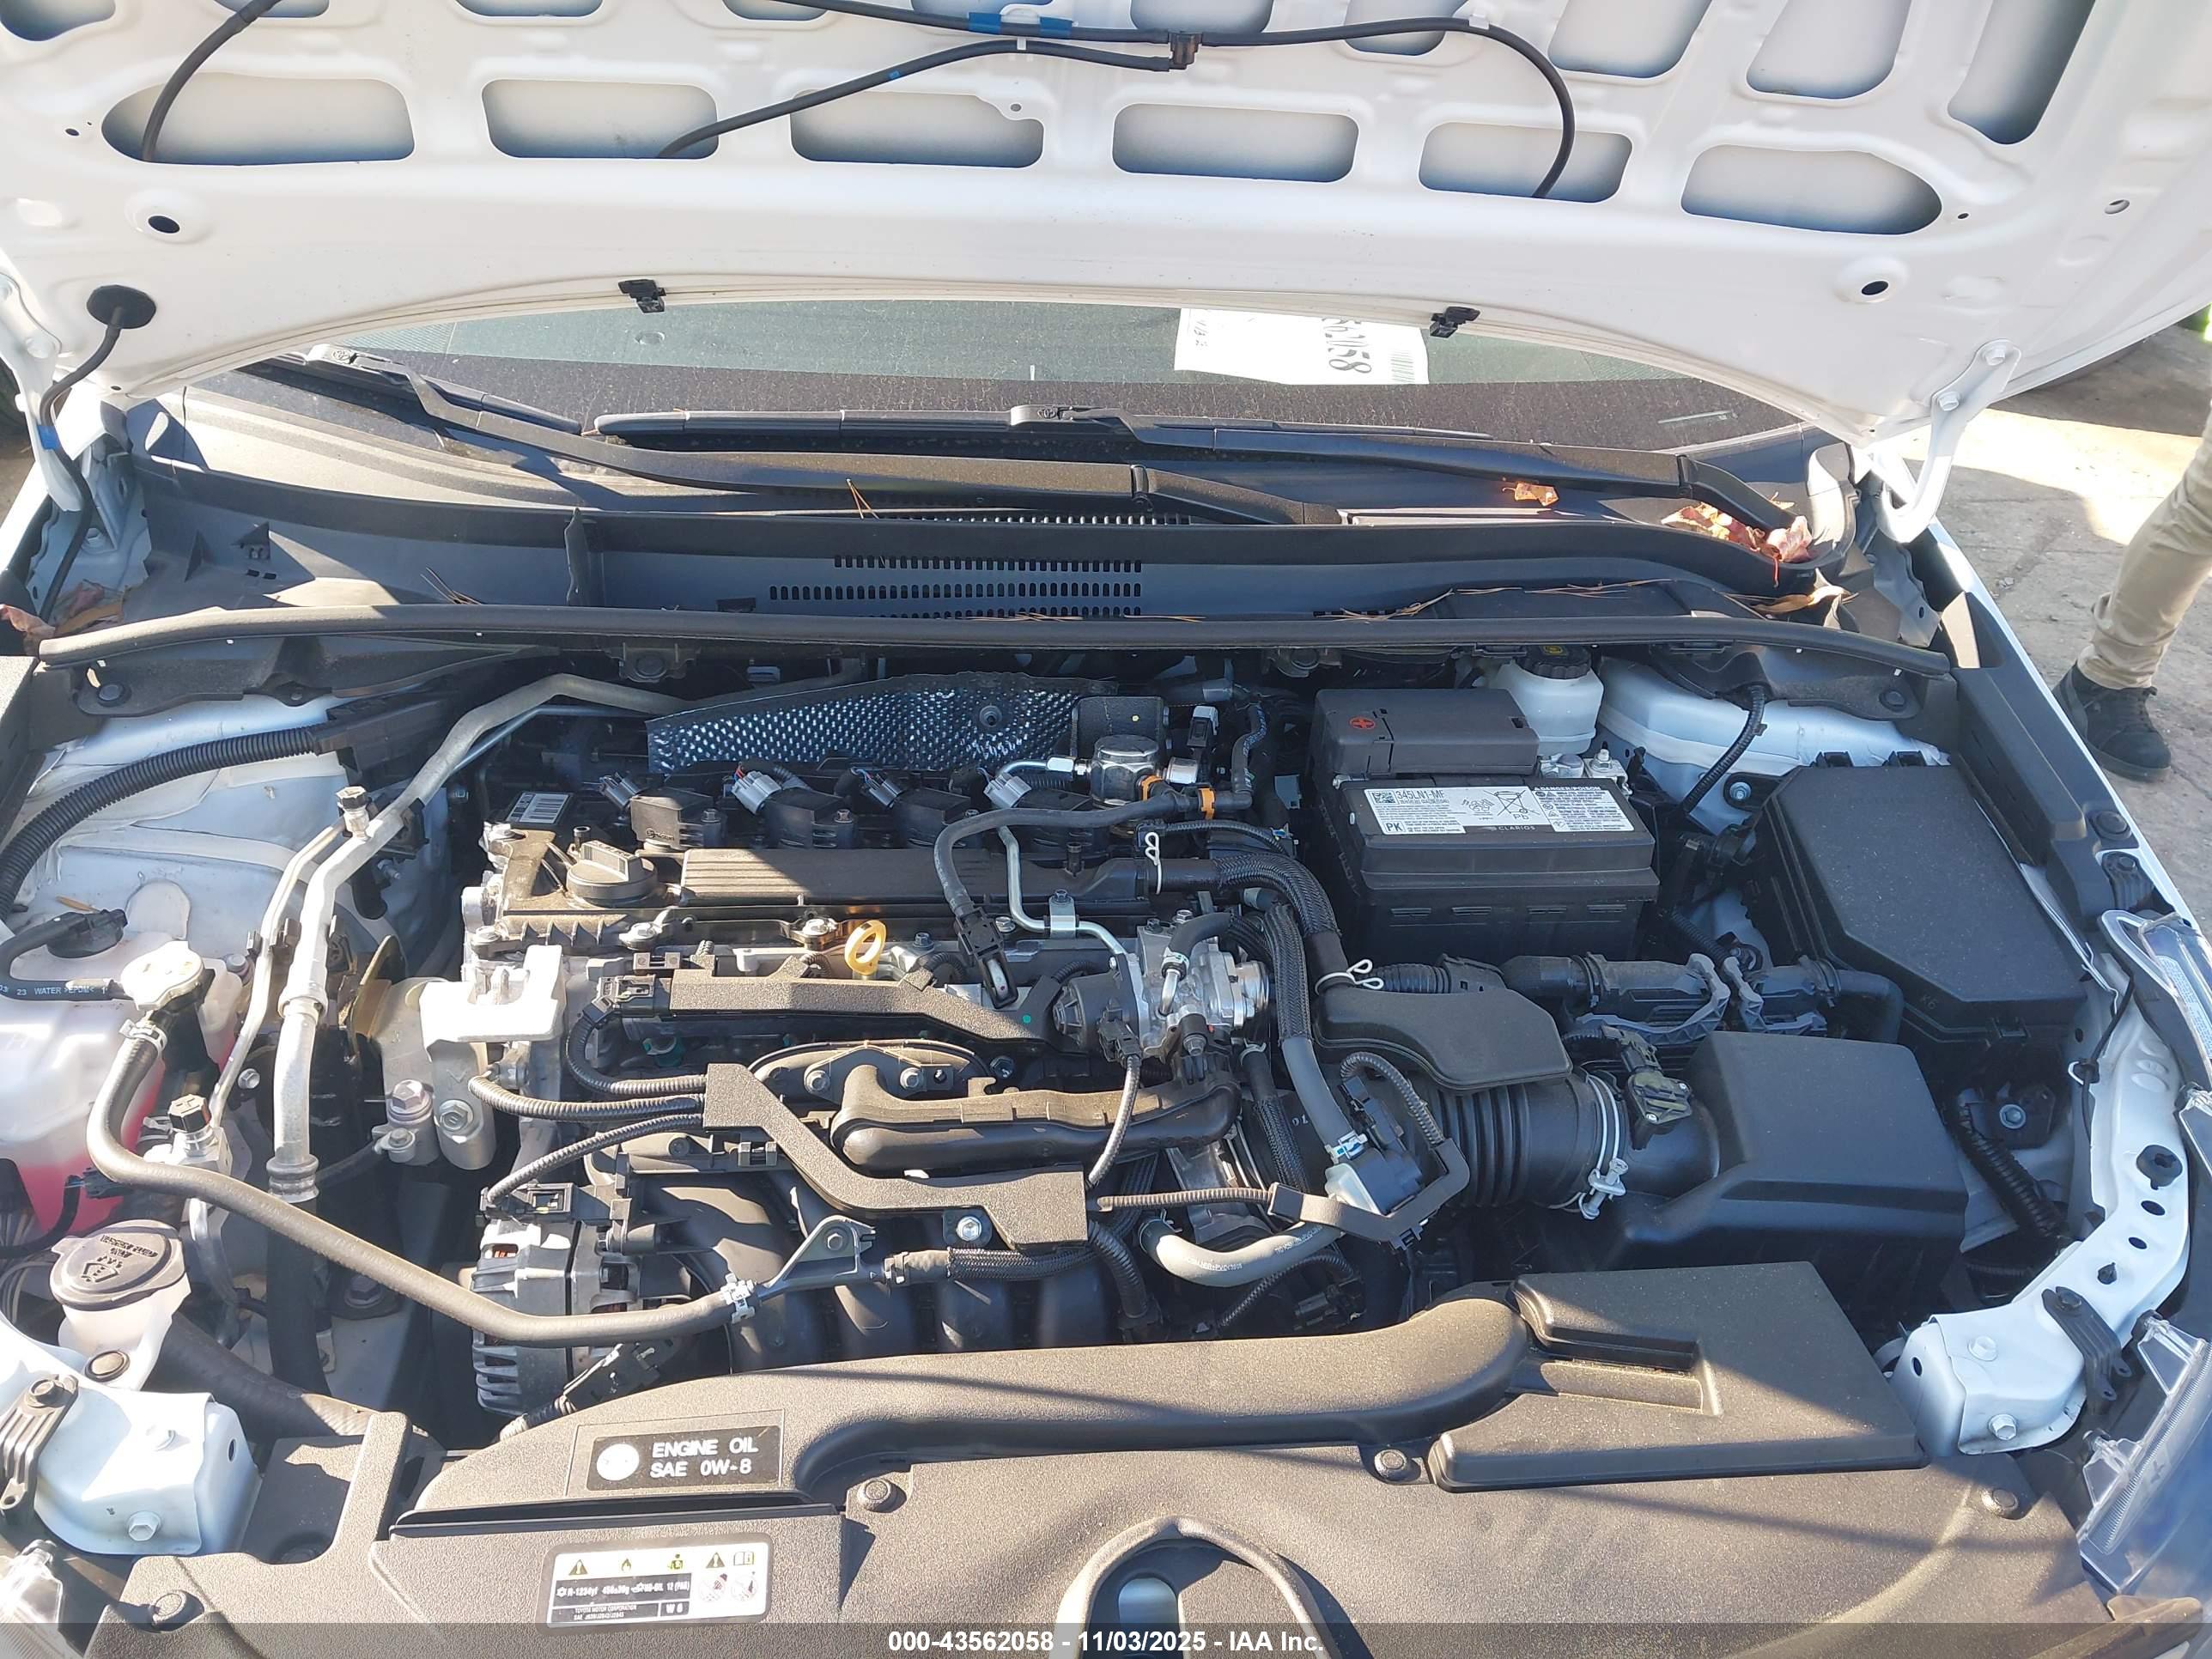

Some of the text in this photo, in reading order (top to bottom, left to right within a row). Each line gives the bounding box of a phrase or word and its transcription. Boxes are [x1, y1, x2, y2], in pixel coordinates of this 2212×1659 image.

[1395, 790, 1444, 799] 345LN1-MF
[1386, 823, 1403, 832] PK
[34, 987, 62, 995] WATER
[652, 1437, 759, 1459] ENGINE OIL
[650, 1457, 752, 1479] SAE 0W-8
